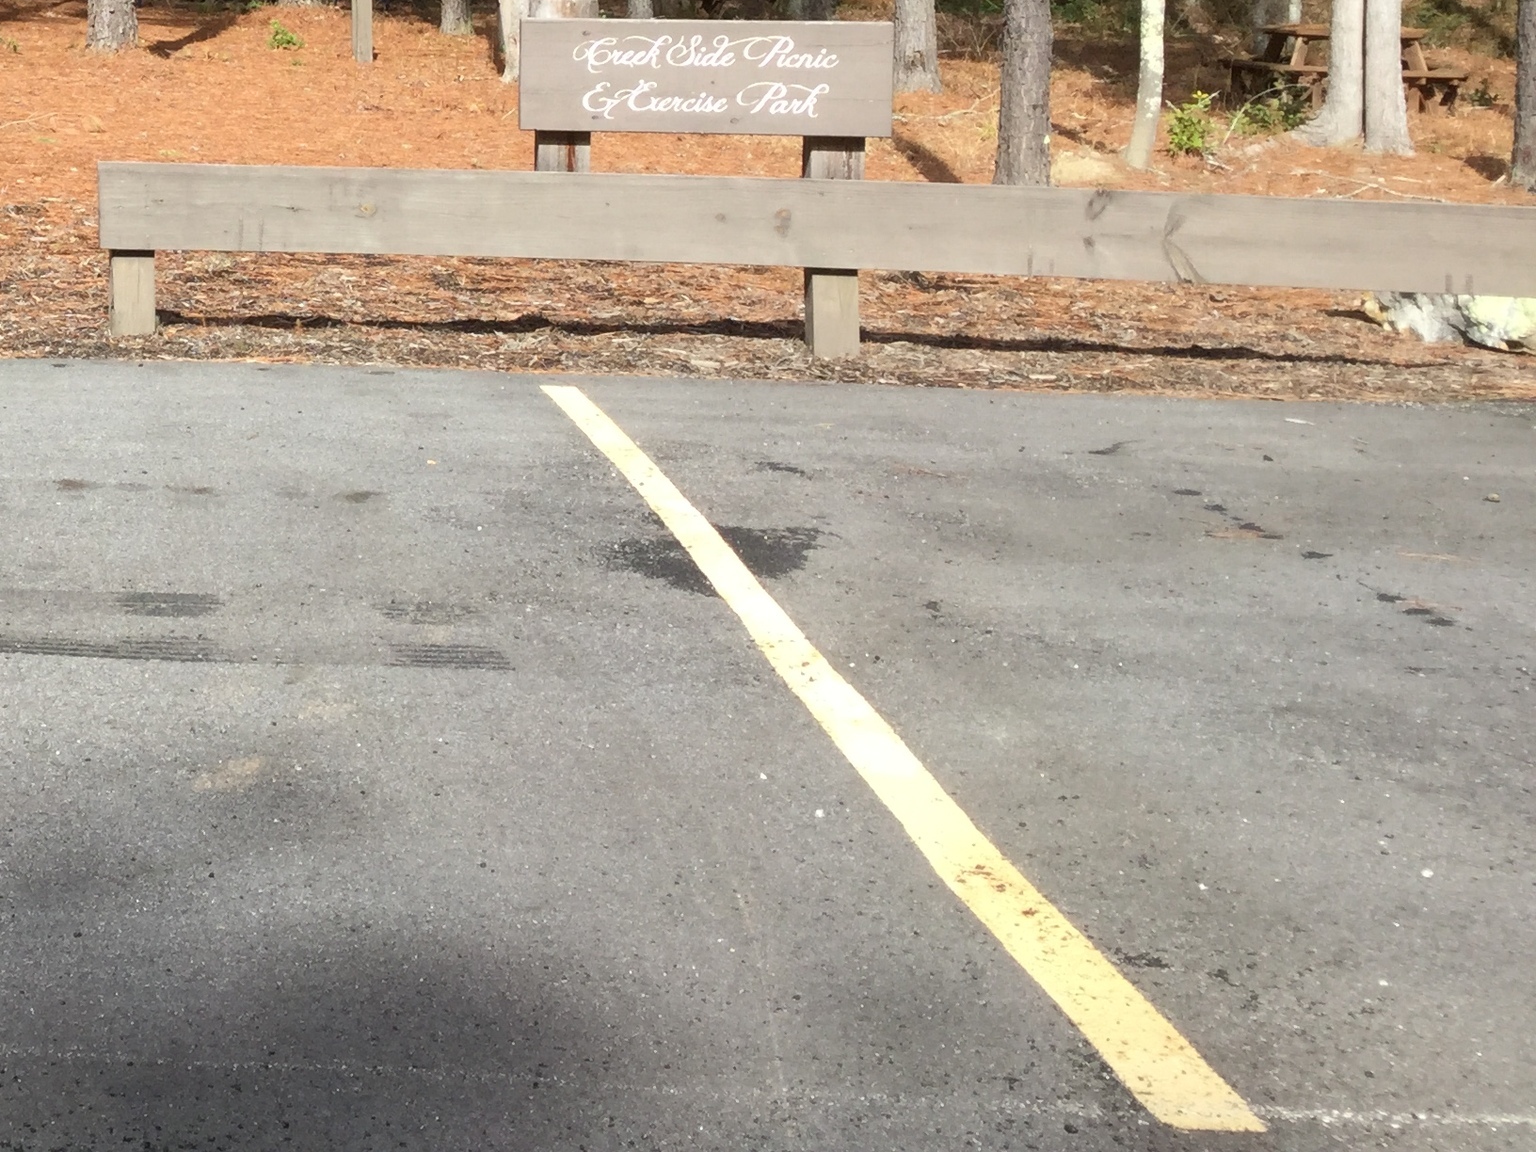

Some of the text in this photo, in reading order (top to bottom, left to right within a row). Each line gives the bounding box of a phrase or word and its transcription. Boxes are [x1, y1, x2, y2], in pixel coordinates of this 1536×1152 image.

[572, 34, 840, 73] Creek Side Picnic
[736, 81, 830, 119] Park
